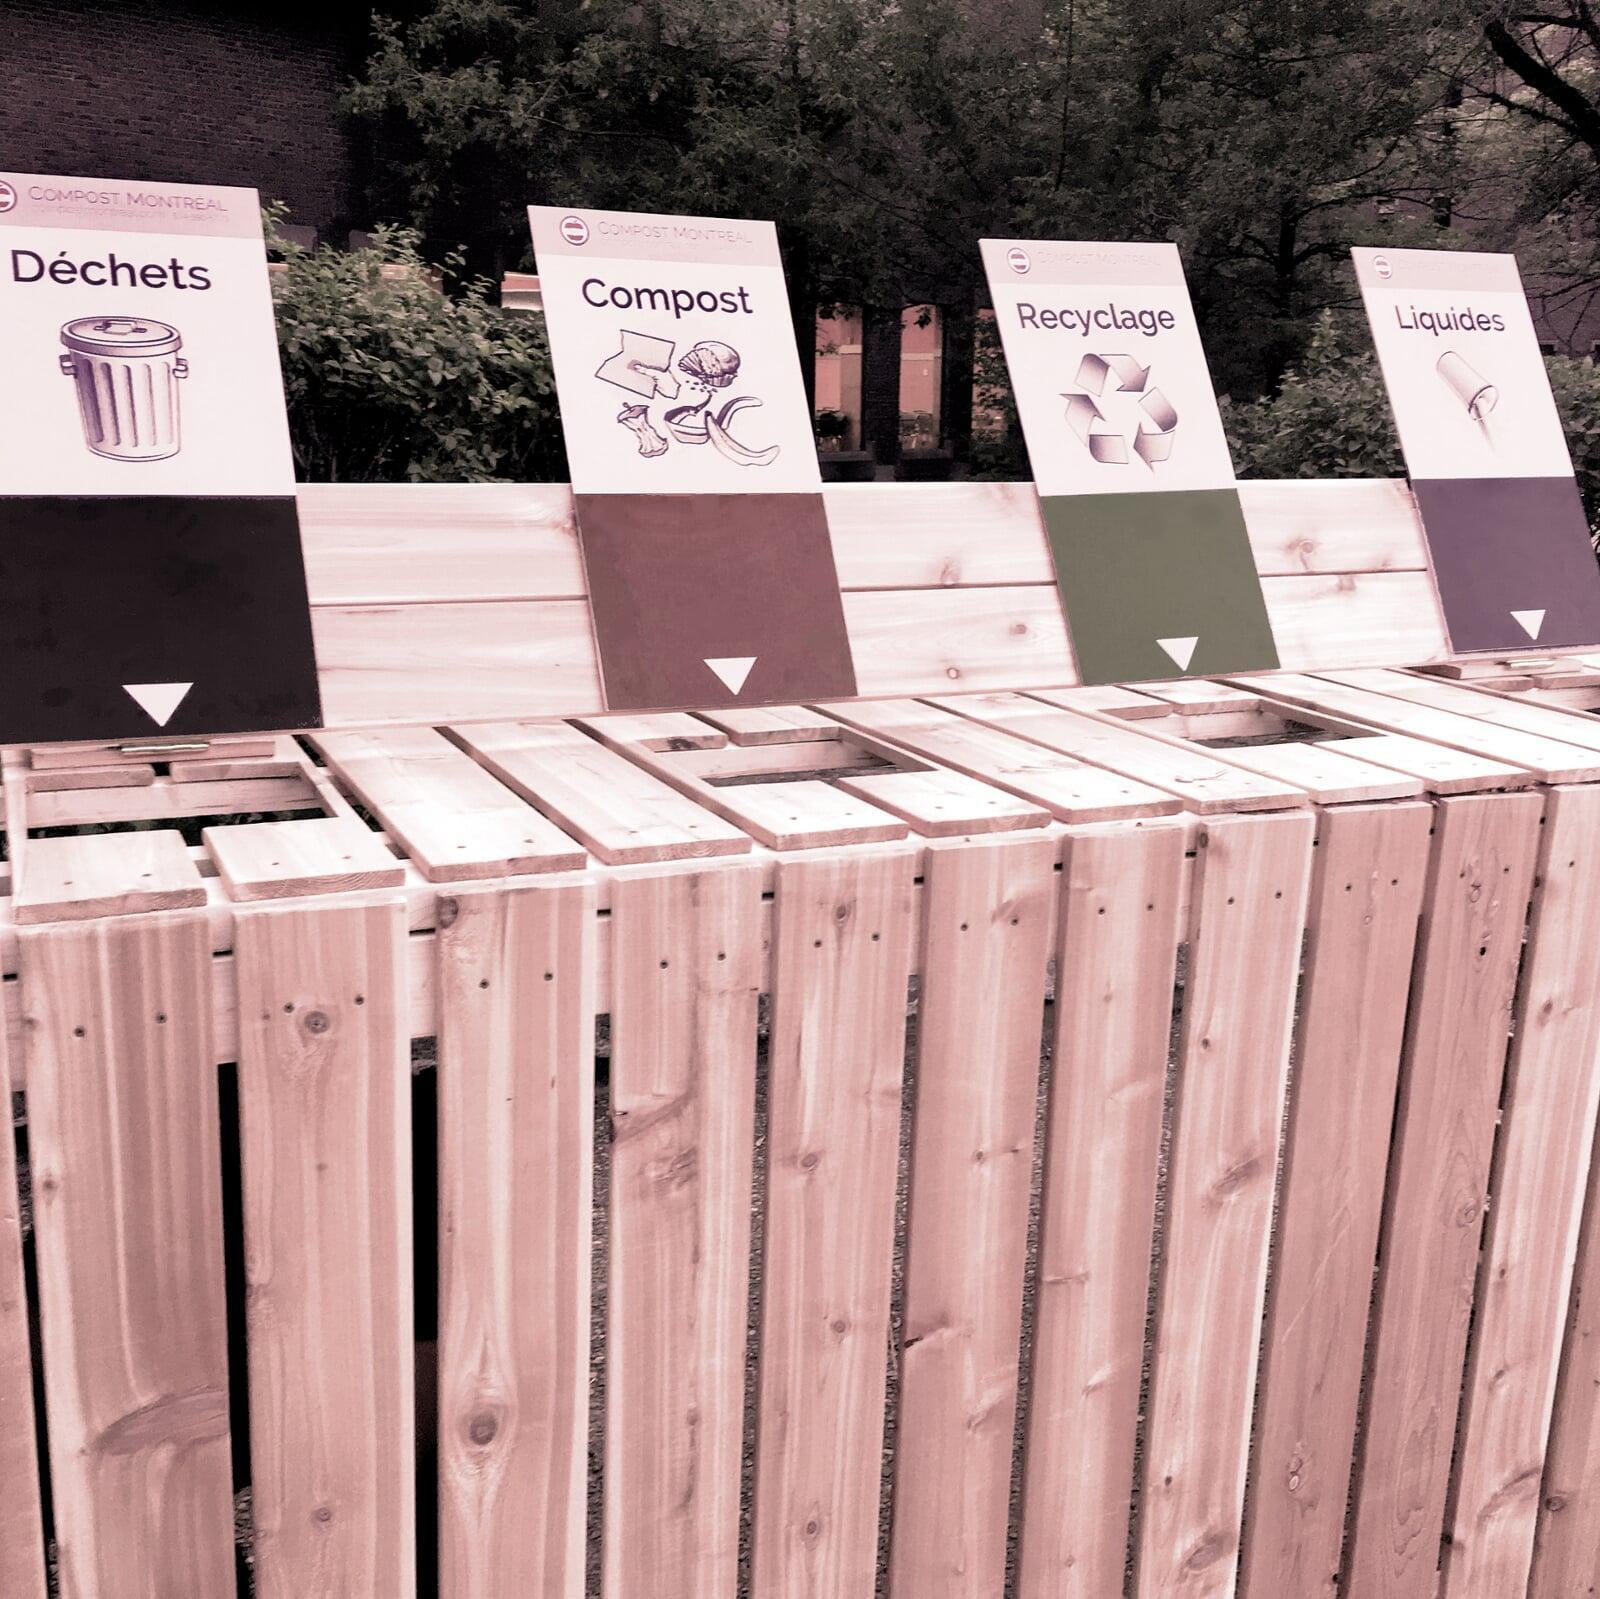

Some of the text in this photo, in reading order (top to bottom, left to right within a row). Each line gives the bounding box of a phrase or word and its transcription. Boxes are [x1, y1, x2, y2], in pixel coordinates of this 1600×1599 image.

[28, 185, 120, 205] COMPOST
[11, 248, 212, 291] Déchets
[581, 277, 754, 320] Compost
[1016, 302, 1176, 337] Recyclage
[1395, 304, 1506, 337] Liquides
